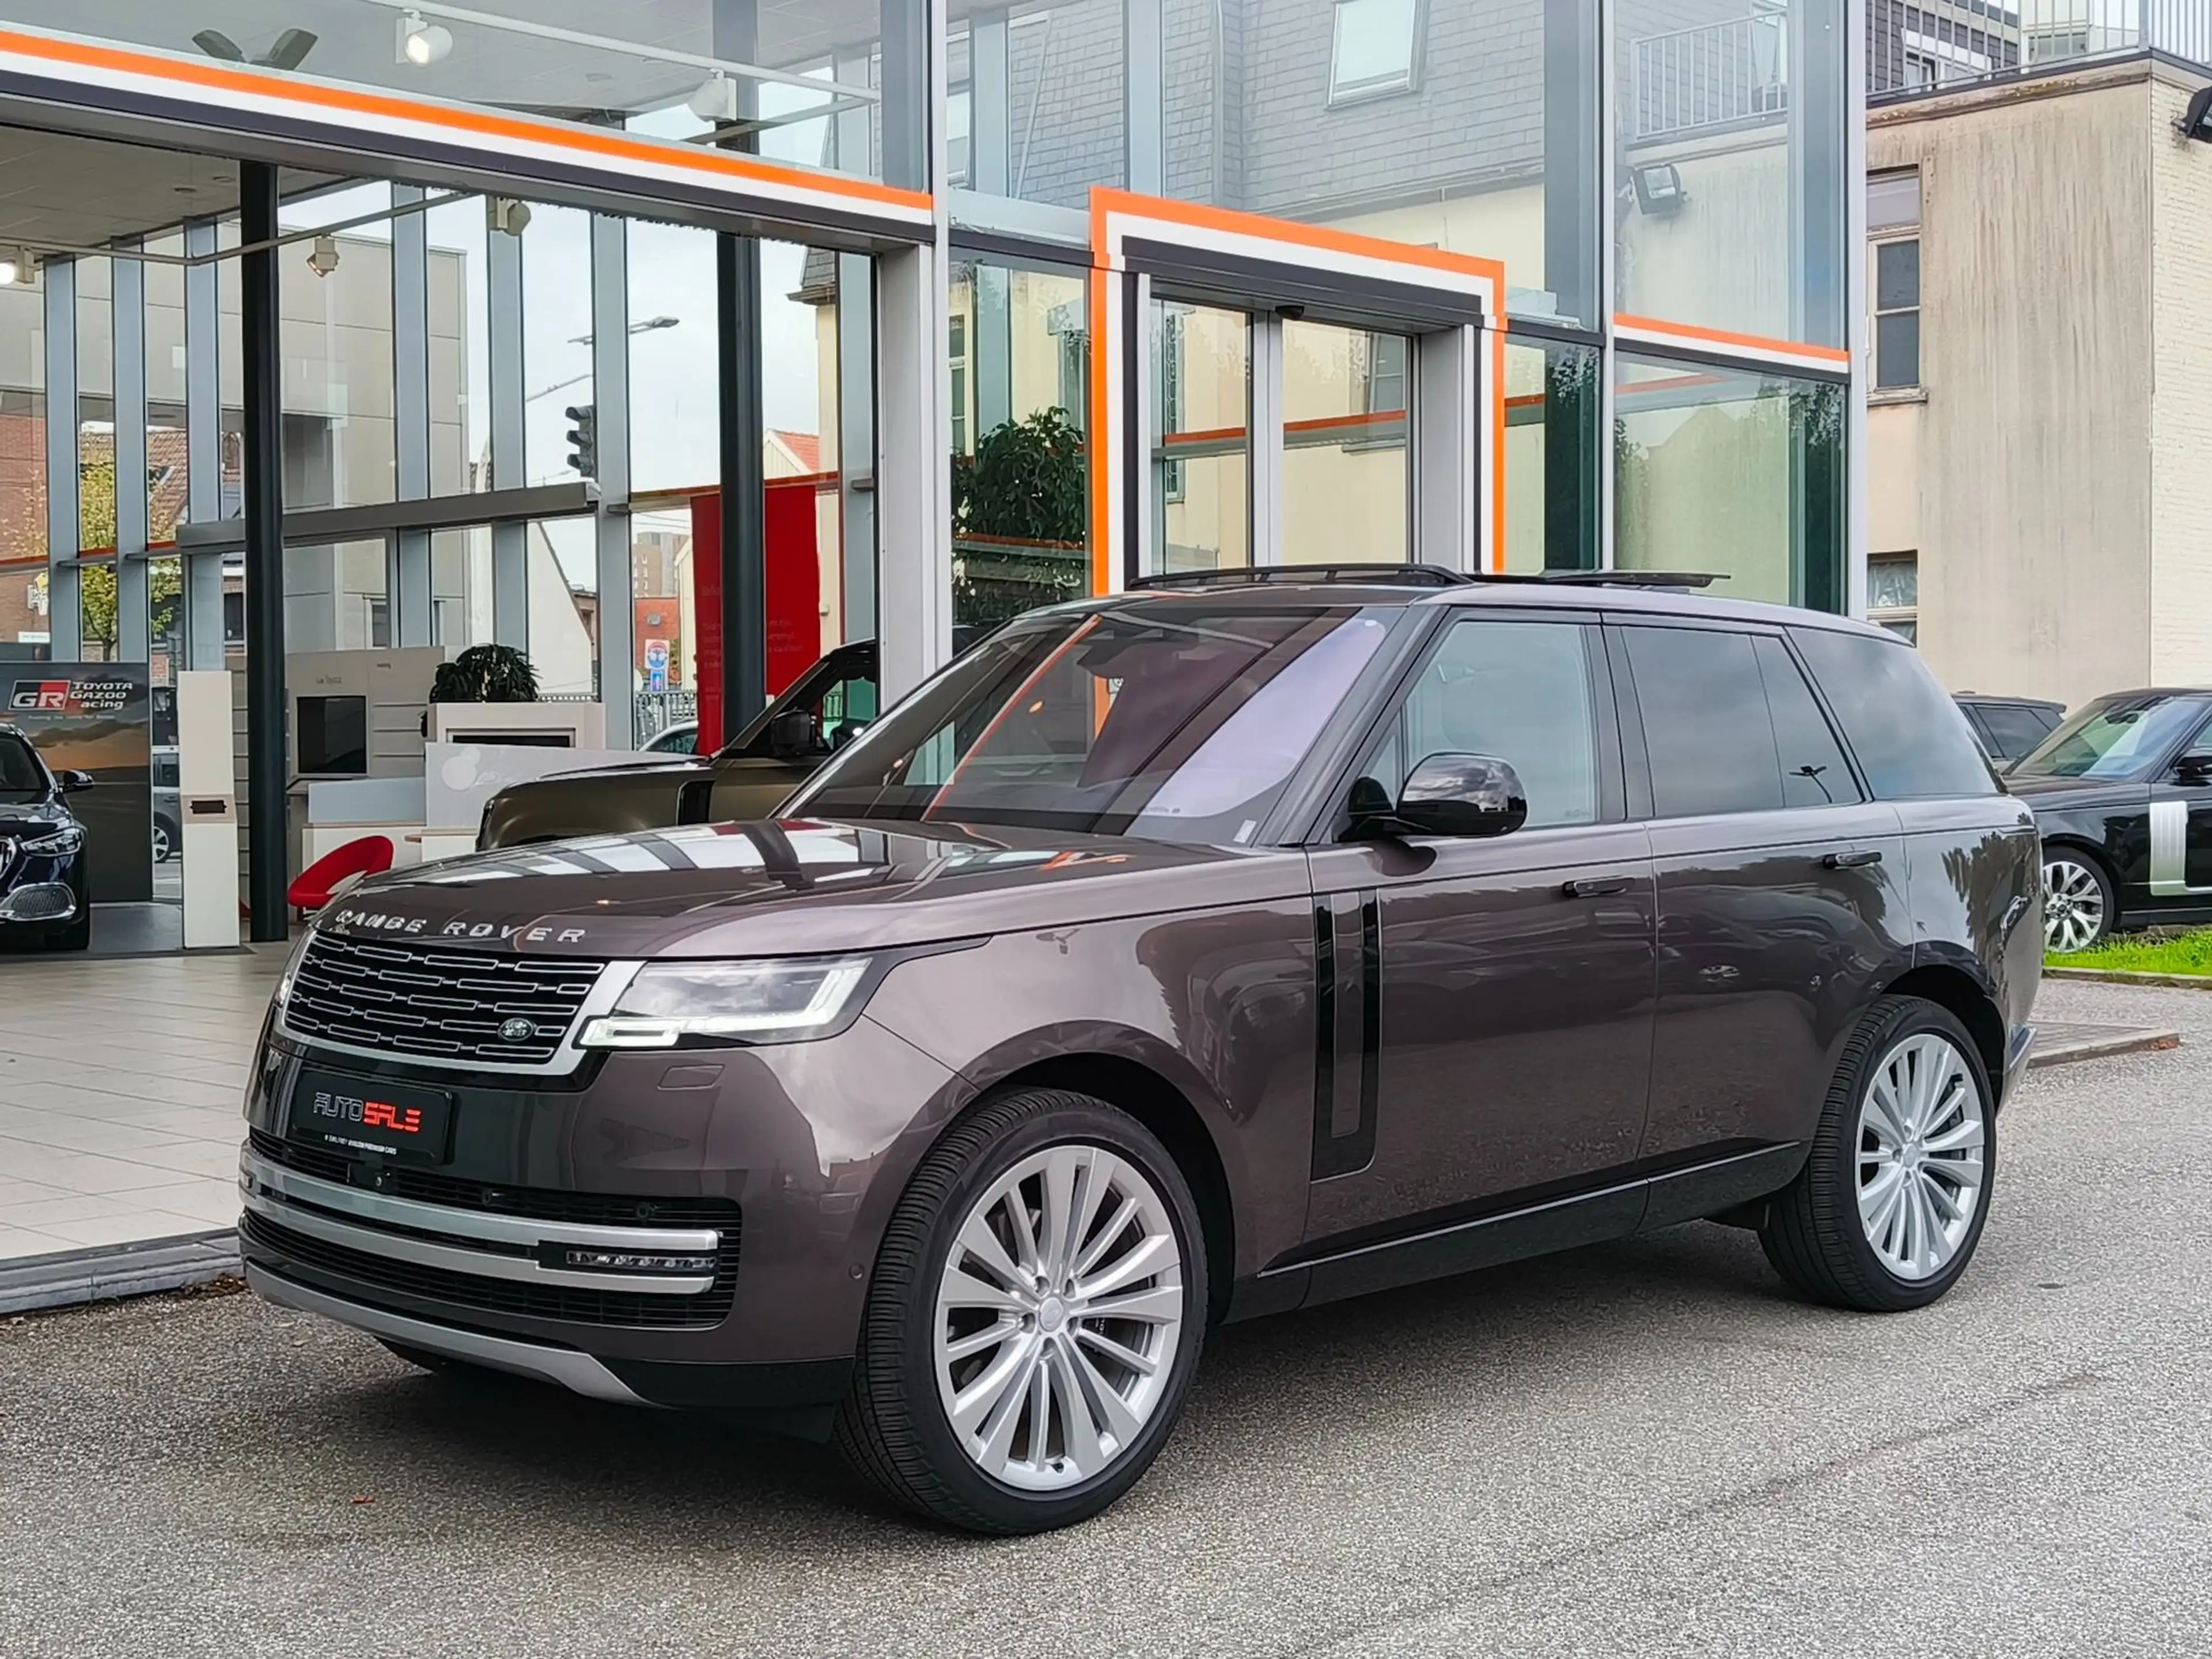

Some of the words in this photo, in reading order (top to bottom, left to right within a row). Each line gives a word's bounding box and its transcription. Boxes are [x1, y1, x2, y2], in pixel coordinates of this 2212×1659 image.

[72, 681, 133, 690] TOYOTA
[13, 692, 64, 707] GR
[70, 691, 127, 699] GAZOO
[335, 908, 427, 933] RANGE
[443, 921, 588, 944] ROVER
